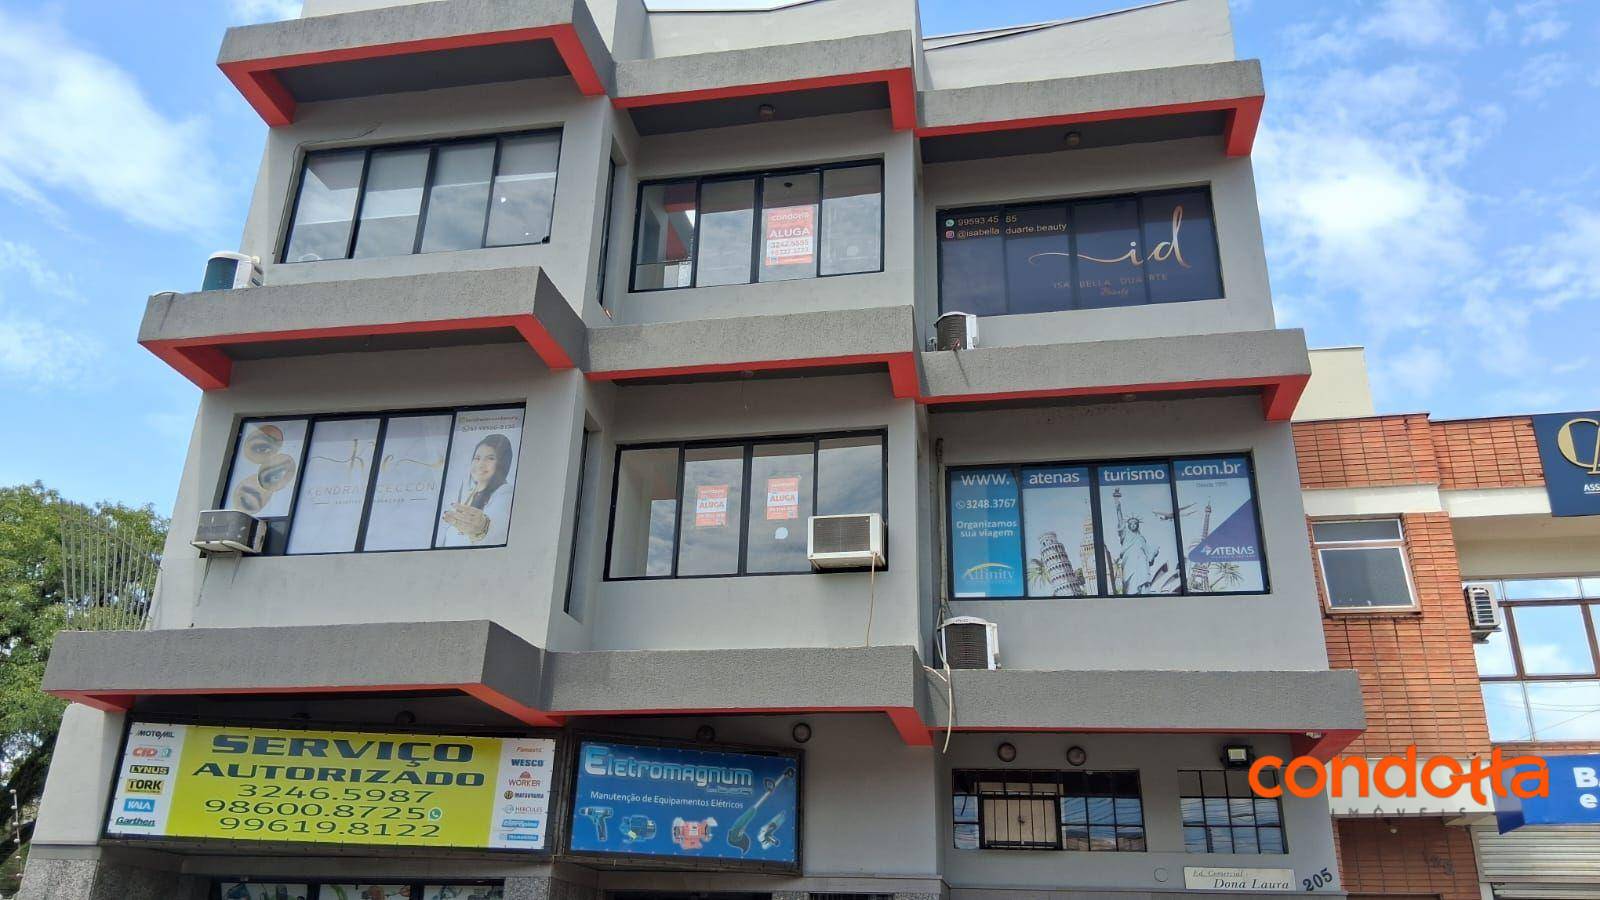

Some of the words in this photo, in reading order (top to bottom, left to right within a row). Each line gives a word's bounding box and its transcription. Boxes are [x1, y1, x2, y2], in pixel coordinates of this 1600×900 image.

[769, 227, 811, 238] ALUGA
[958, 226, 1000, 239] @isabella
[1005, 223, 1068, 236] duarte.beauty
[1028, 471, 1080, 484] atenas
[1103, 467, 1165, 482] turismo
[1181, 461, 1241, 476] .com.br
[699, 500, 725, 509] ALUGA
[769, 493, 796, 503] ALUGA
[965, 498, 1016, 509] 3248.3767
[956, 520, 1017, 530] Organizamos
[1209, 545, 1255, 556] ATENAS
[211, 734, 474, 768] SERVIÇO
[511, 758, 545, 767] WESCO
[584, 745, 753, 787] Eletromagnum
[131, 765, 169, 775] LYNUS
[191, 762, 485, 787] AUTORIZADO
[1573, 767, 1600, 787] B
[129, 778, 162, 790] TORK
[508, 778, 541, 787] WORKER
[237, 784, 435, 803] 3246.5987
[590, 790, 641, 805] Manutenção
[642, 794, 653, 803] de
[654, 795, 709, 808] Equipamentos
[711, 798, 744, 810] Elétricos
[1579, 793, 1598, 809] e
[205, 799, 426, 820] 98600.8725
[116, 816, 156, 827] Garthen
[220, 817, 441, 837] 99619.8122
[1213, 878, 1246, 888] Dona
[1250, 878, 1289, 889] Laura
[1302, 867, 1333, 892] 205
